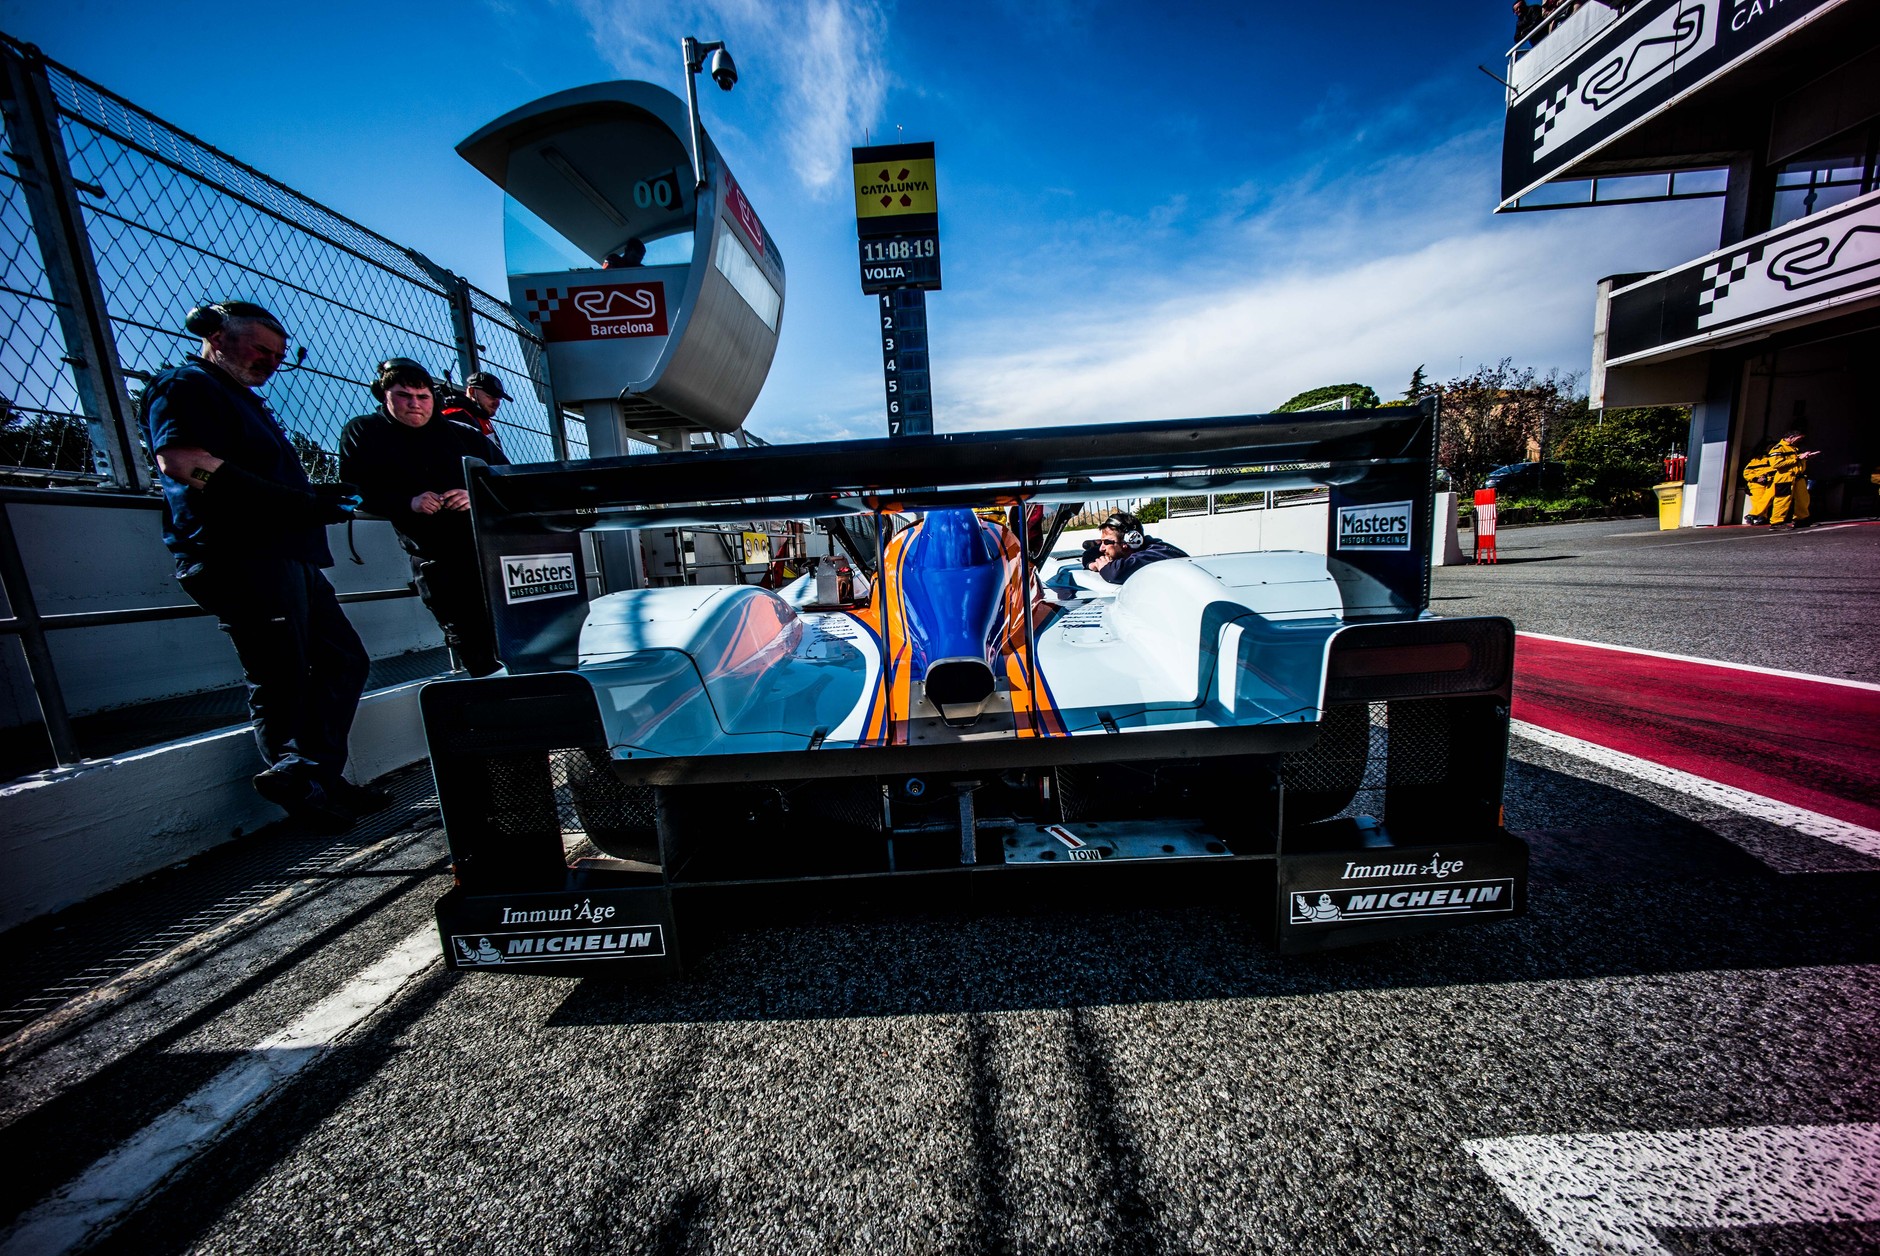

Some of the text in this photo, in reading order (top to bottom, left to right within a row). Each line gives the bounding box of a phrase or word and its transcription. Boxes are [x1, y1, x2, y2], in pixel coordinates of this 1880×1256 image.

[633, 180, 672, 209] 00
[861, 181, 929, 195] CATALUNYA
[864, 239, 934, 261] 11:08:19
[864, 267, 905, 280] VOLTA
[883, 295, 890, 308] 1
[591, 321, 654, 336] Barcelona
[884, 317, 893, 329] 2
[885, 338, 894, 351] 3
[886, 359, 896, 371] 4
[888, 380, 897, 392] 5
[890, 401, 899, 413] 6
[891, 422, 900, 434] 7
[1342, 513, 1407, 534] Masters
[1341, 535, 1406, 544] HISTORIC RACING
[507, 563, 572, 586] Masters
[511, 581, 574, 597] HISTORIC RACING
[1070, 850, 1100, 860] TOW
[1346, 886, 1503, 911] MICHELIN
[507, 932, 652, 955] MICHELIN
